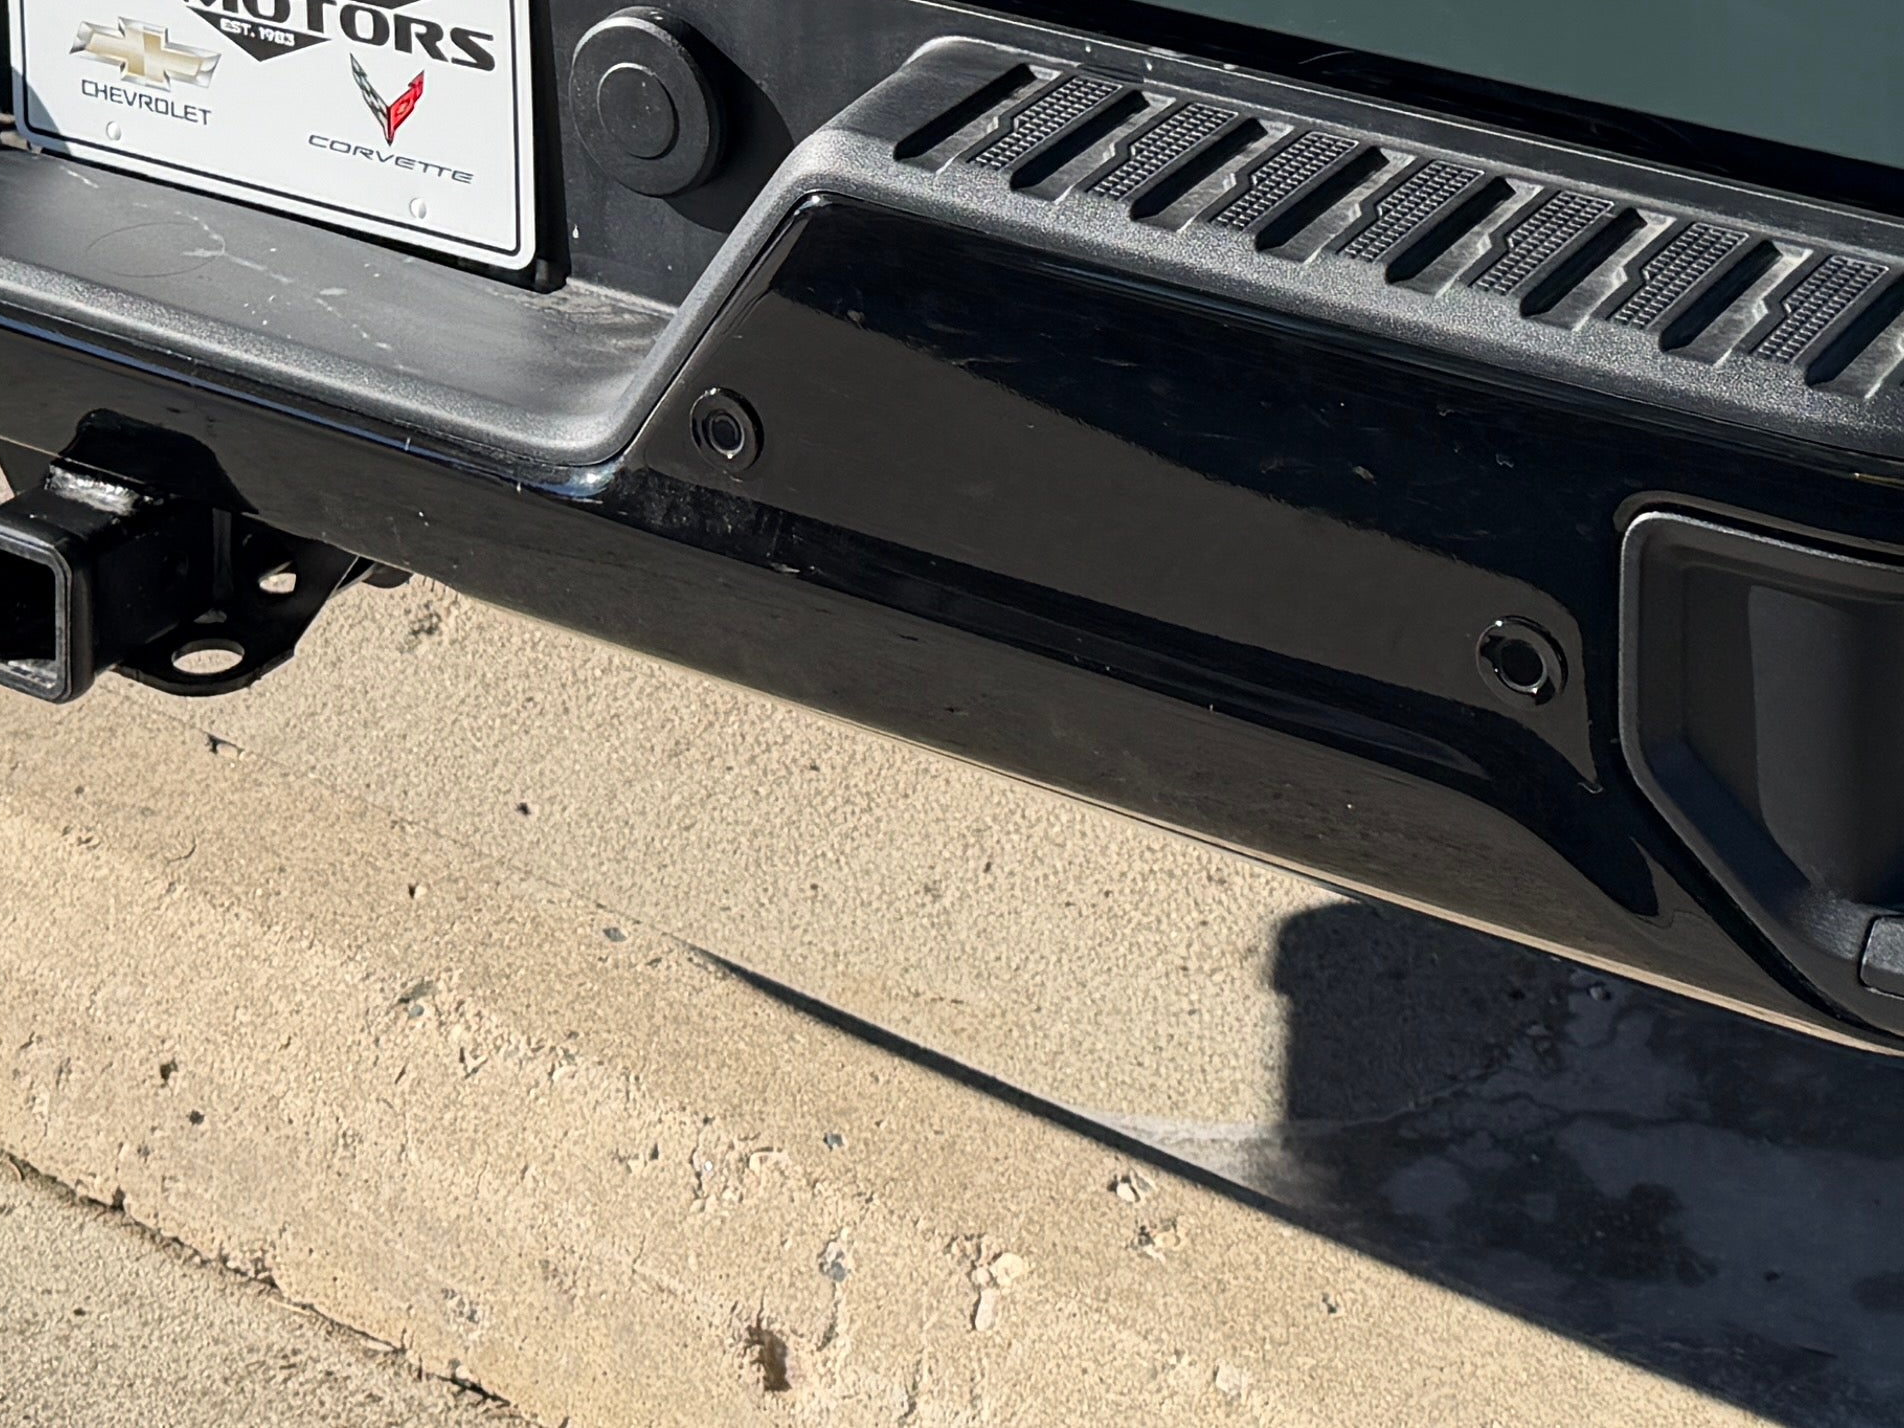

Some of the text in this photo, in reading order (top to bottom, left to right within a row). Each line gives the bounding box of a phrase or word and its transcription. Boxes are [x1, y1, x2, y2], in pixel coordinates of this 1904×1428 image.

[219, 17, 257, 38] EST.
[80, 78, 212, 126] CHEVROLET
[307, 134, 475, 184] CORVETTE
